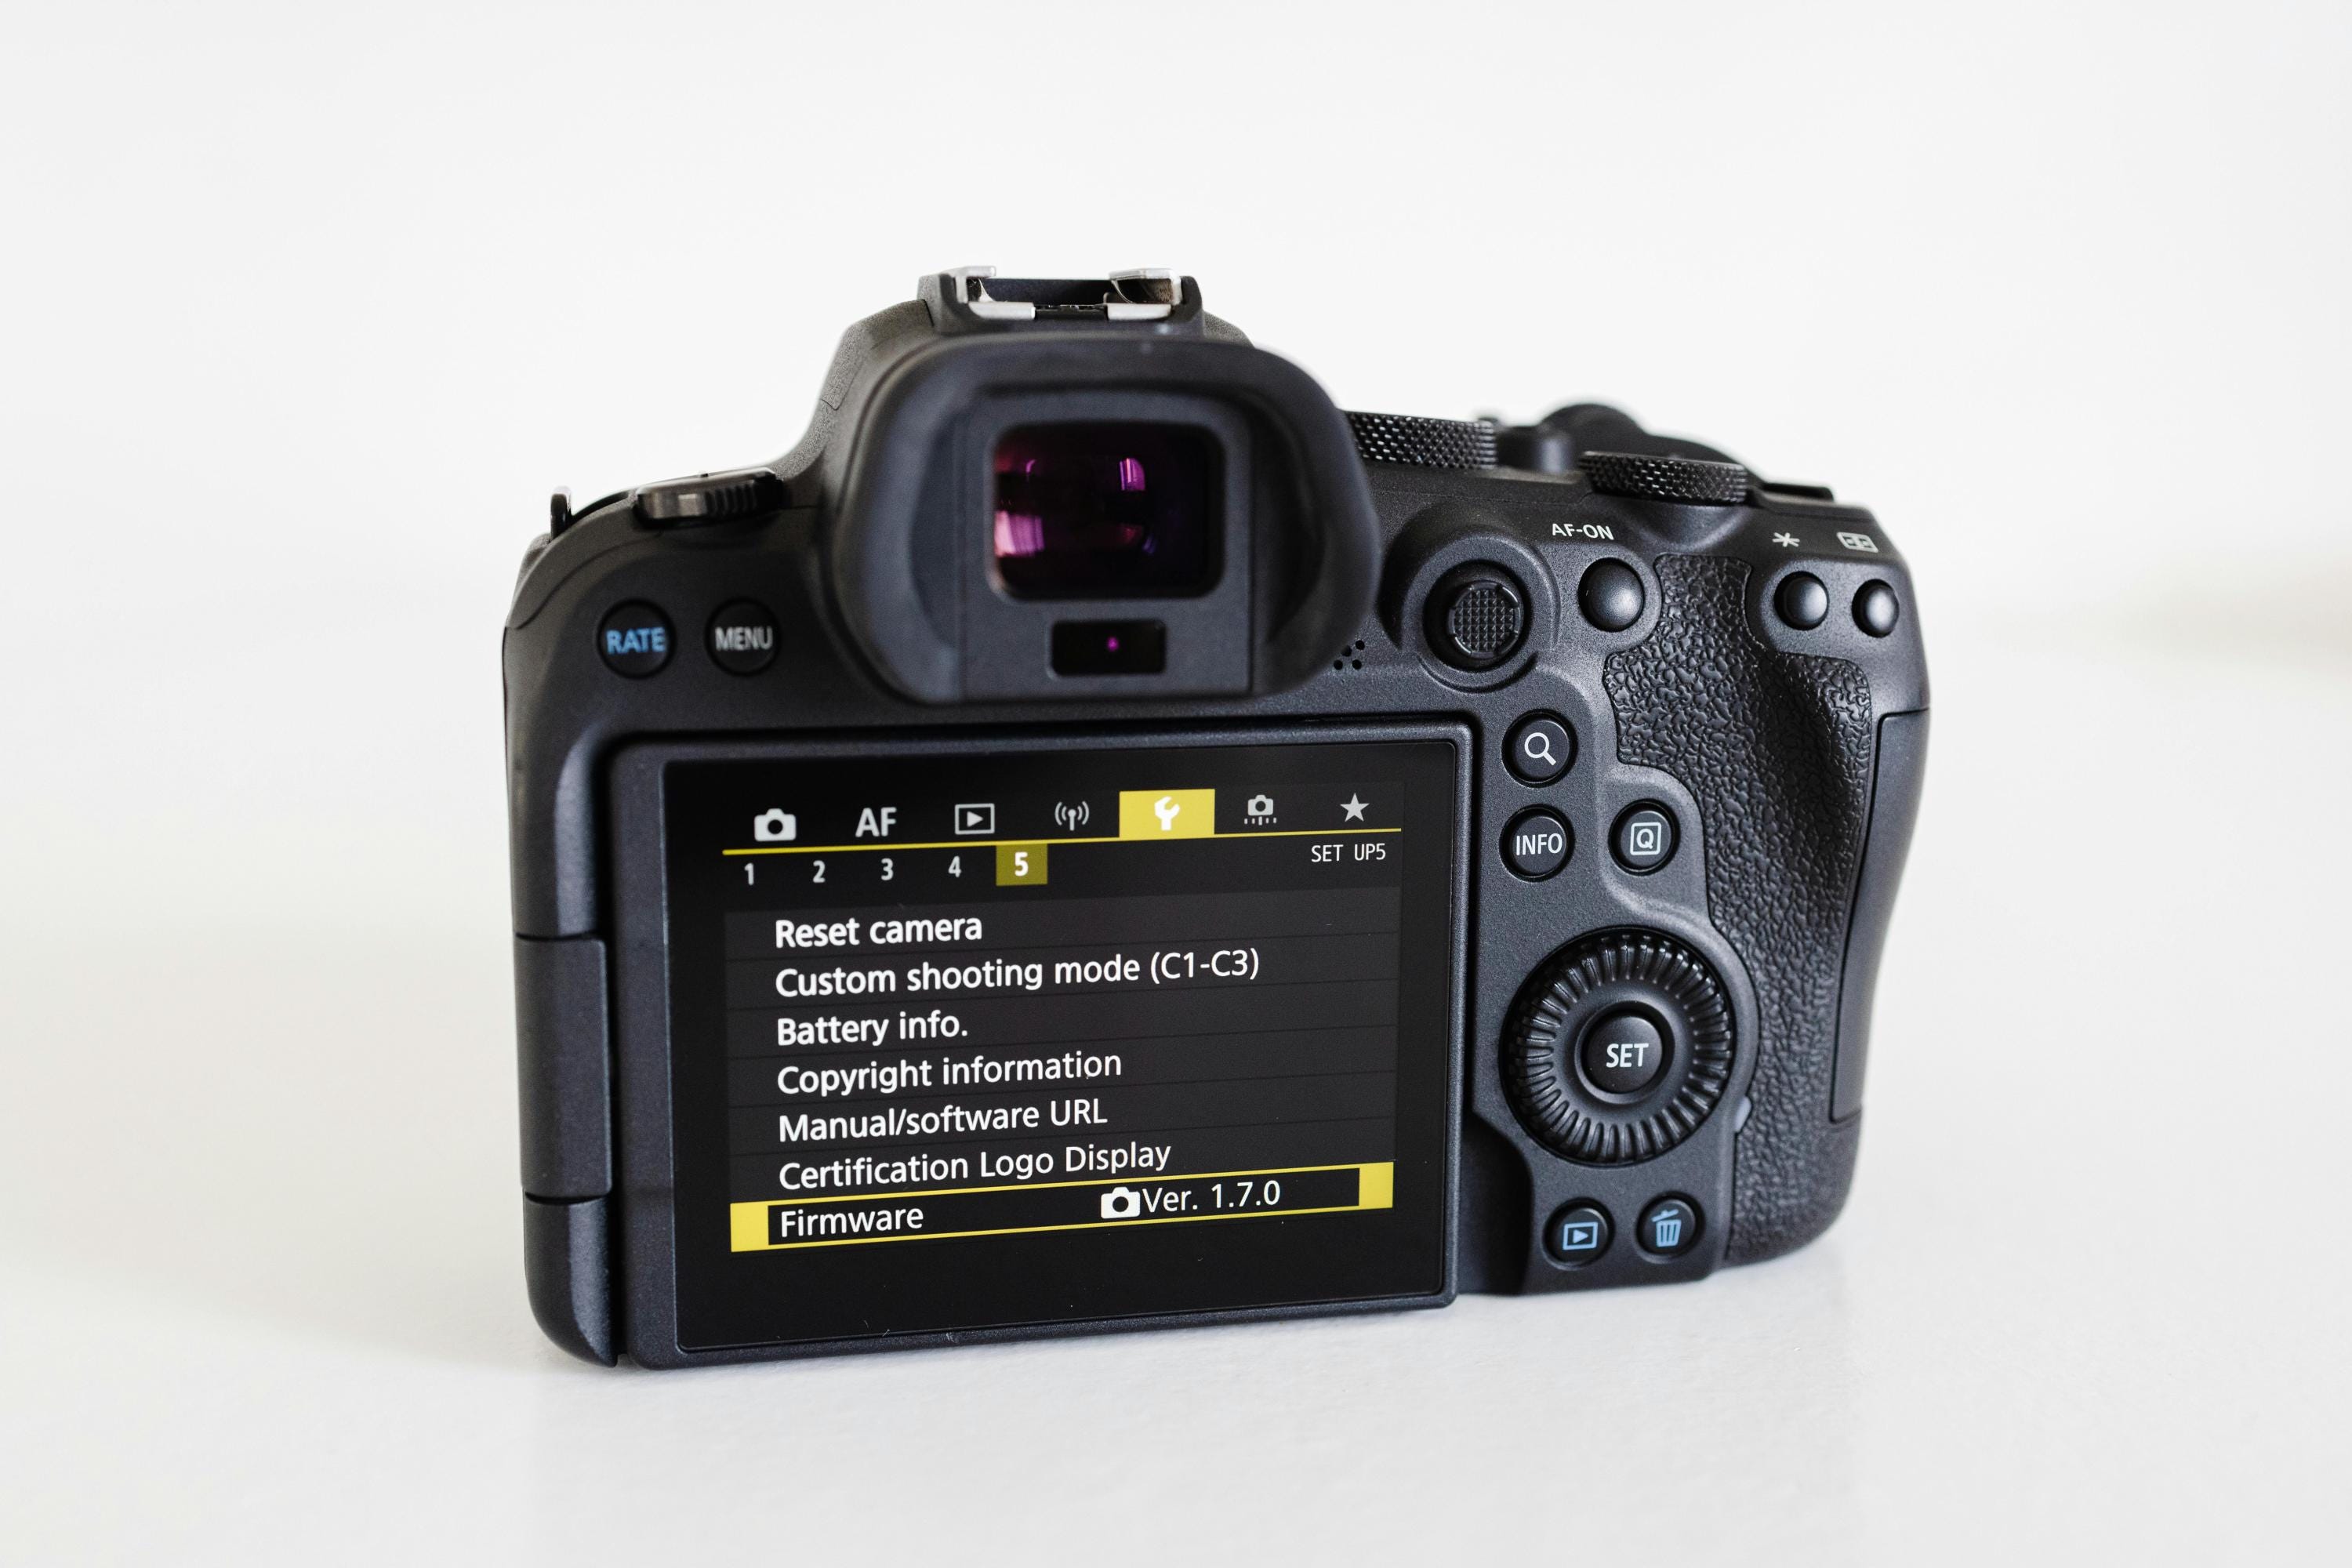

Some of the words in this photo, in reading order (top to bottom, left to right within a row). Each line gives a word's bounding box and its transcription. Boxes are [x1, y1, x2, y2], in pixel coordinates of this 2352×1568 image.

[1552, 523, 1614, 540] AF-ON
[606, 626, 666, 654] RATE
[714, 626, 772, 651] MENU
[855, 807, 897, 838] AF
[1311, 844, 1344, 863] SET
[1354, 843, 1386, 861] UP5
[1515, 833, 1563, 856] INFO
[1635, 828, 1654, 850] Q
[744, 862, 754, 886] 1
[812, 860, 826, 884] 2
[880, 858, 894, 881] 3
[948, 855, 962, 878] 4
[1014, 851, 1029, 877] 5
[775, 917, 860, 949] Reset
[869, 917, 982, 945] camera
[775, 967, 896, 997] Custom
[906, 958, 1043, 992] shooting
[1054, 953, 1141, 985] mode
[1150, 947, 1259, 985] (C1-C3)
[777, 1016, 890, 1047] Battery
[899, 1009, 968, 1040] info.
[1606, 1042, 1650, 1068] SET
[777, 1059, 932, 1098] Copyright
[943, 1050, 1122, 1085] information
[779, 1104, 1040, 1142] Manual/software
[1051, 1098, 1108, 1127] URL
[779, 1153, 968, 1190] Certification
[980, 1151, 1054, 1180] Logo
[1065, 1141, 1171, 1174] Display
[781, 1207, 924, 1238] Firmware
[1142, 1187, 1198, 1213] Ver.
[1211, 1180, 1281, 1209] 1.7.0
